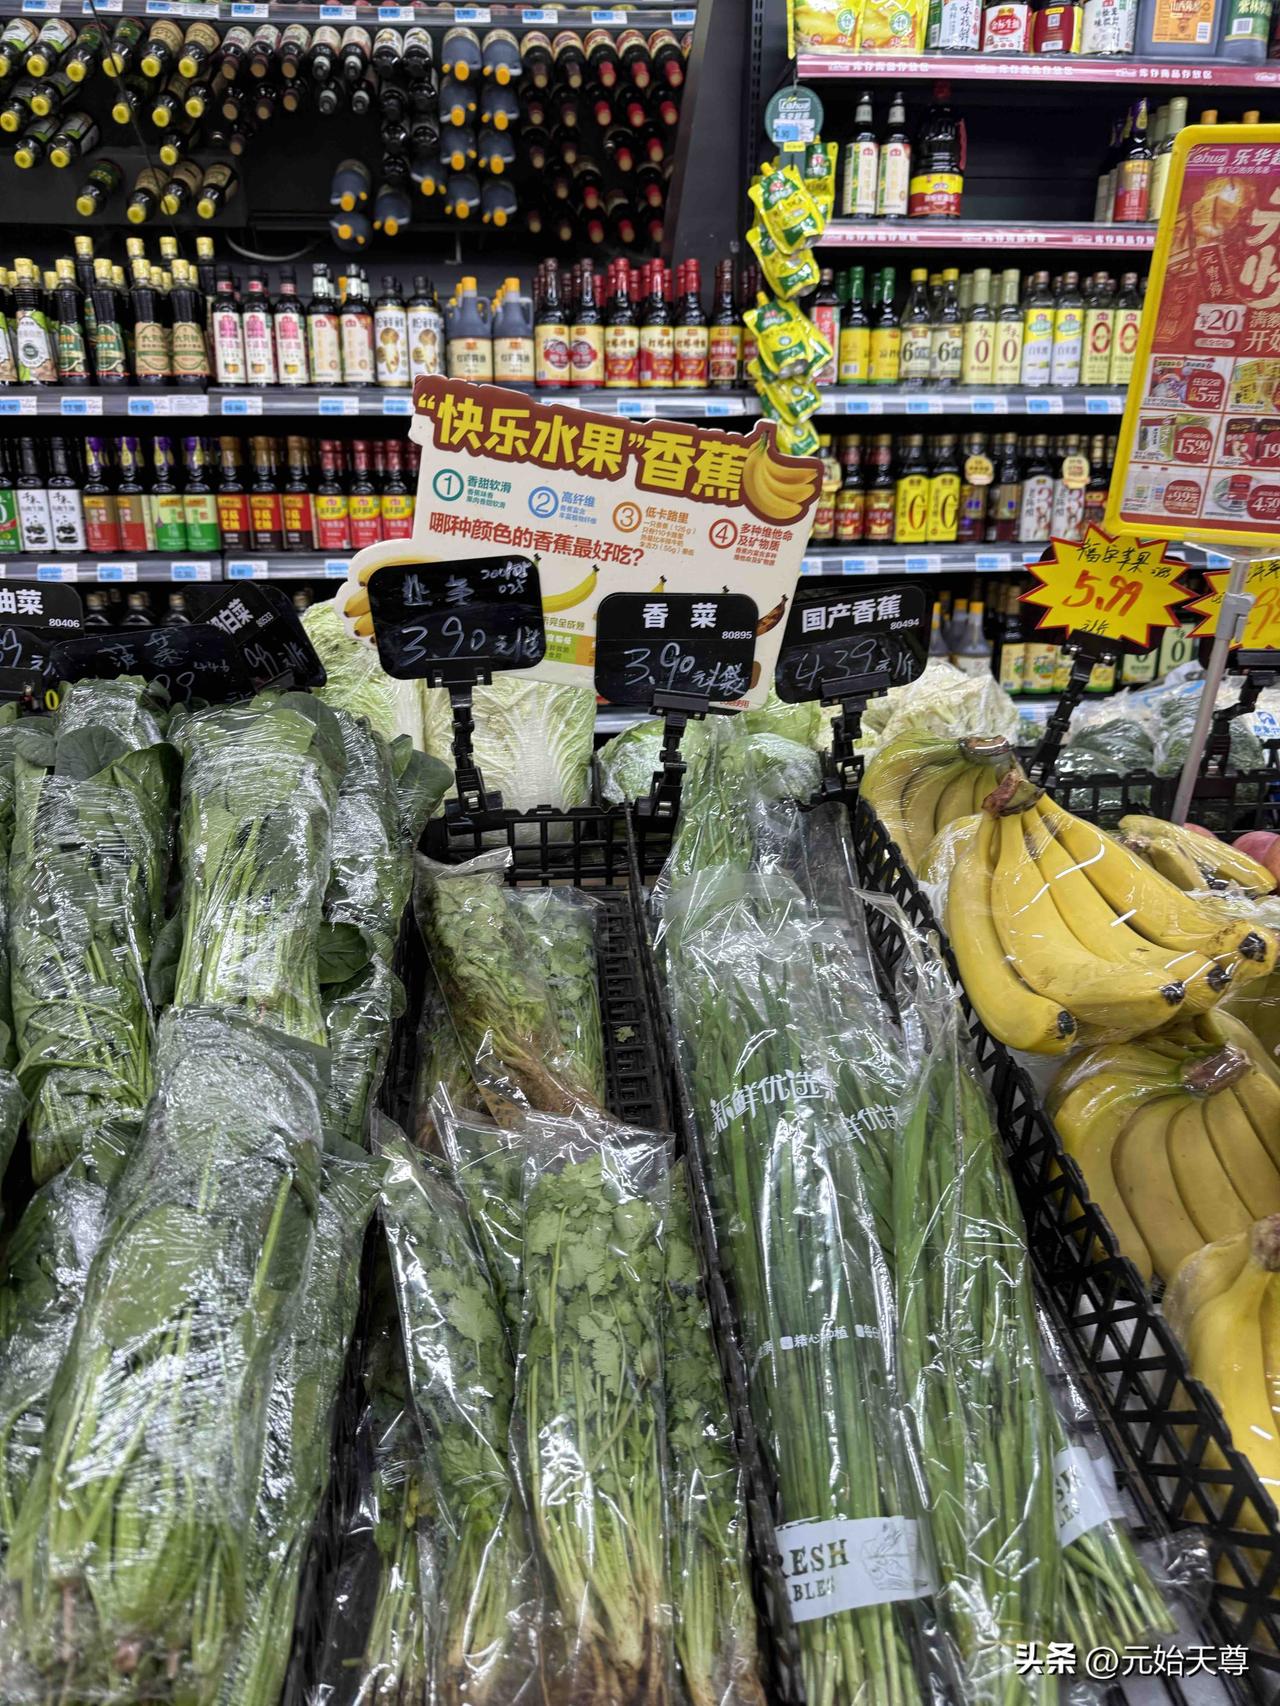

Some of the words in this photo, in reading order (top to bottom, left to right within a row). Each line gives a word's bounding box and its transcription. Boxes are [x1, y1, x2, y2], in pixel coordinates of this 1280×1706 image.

[418, 393, 750, 500] “快乐水果”香蕉
[467, 475, 512, 493] 香甜软滑
[562, 491, 595, 508] 高纤维
[645, 506, 689, 525] 低卡路里
[740, 523, 794, 542] 多种维他命
[737, 535, 781, 552] 及矿物质
[48, 618, 80, 628] 80406
[642, 602, 719, 629] 香菜
[801, 594, 902, 633] 国产香蕉
[889, 618, 920, 631] 80494
[401, 615, 487, 667] 3.90
[721, 630, 753, 640] 80895
[623, 642, 696, 691] 3.90
[709, 1068, 826, 1142] 新鲜优选
